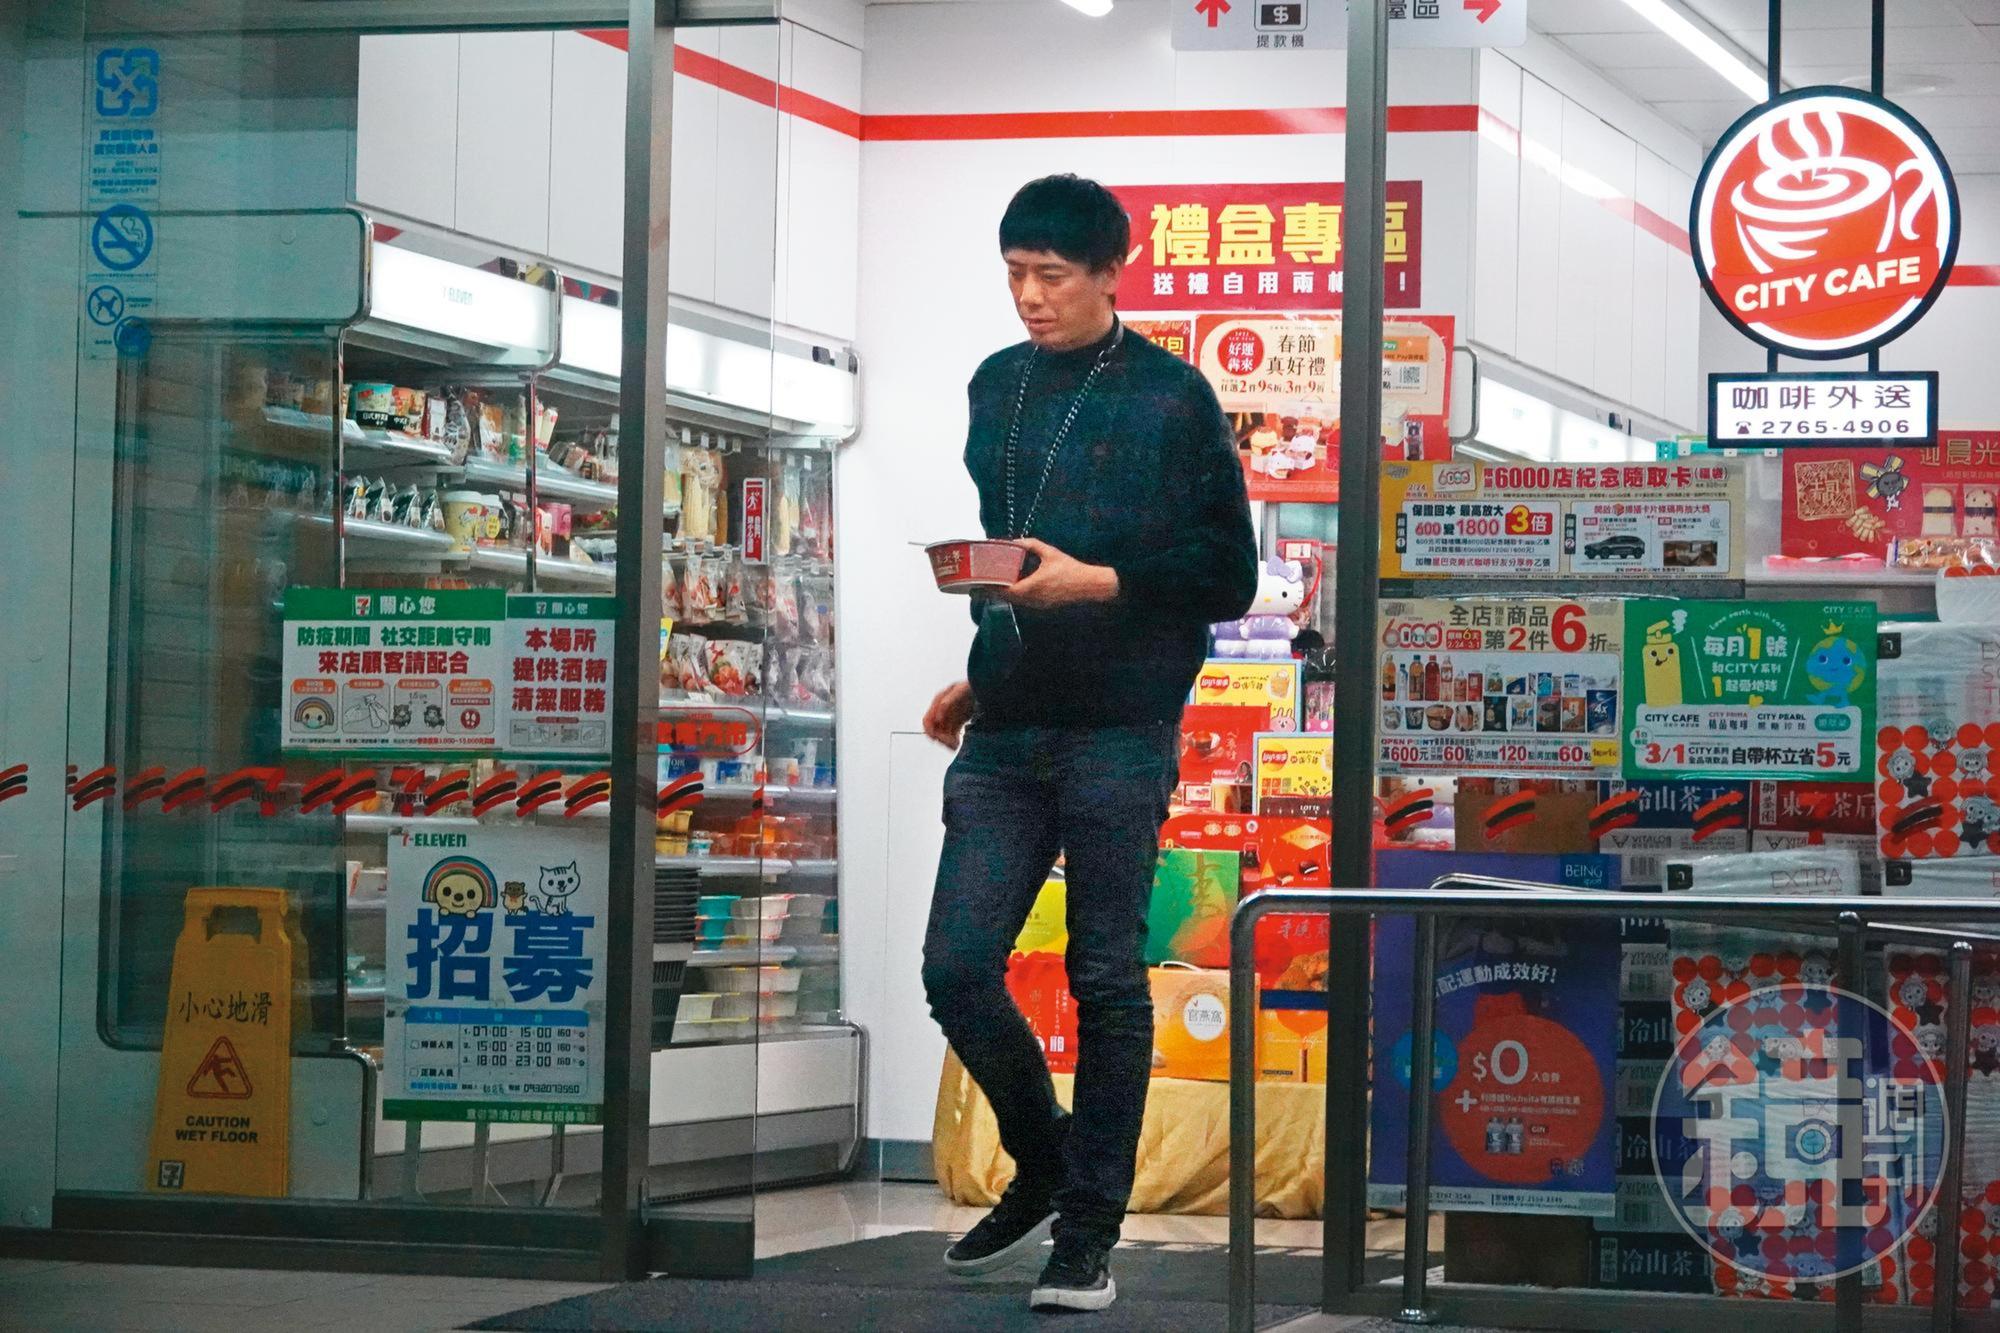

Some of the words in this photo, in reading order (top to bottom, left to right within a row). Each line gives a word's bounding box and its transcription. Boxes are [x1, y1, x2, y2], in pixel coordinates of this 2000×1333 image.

[1256, 34, 1305, 49] 提款機
[1735, 273, 1817, 312] CITY
[1824, 256, 1921, 297] CAFE
[1228, 341, 1255, 356] 好運
[1279, 334, 1316, 354] 春節
[1266, 356, 1326, 376] 真好禮
[1732, 384, 1912, 410] 咖啡外送
[1761, 420, 1910, 434] 2765-4906
[1412, 504, 1456, 517] 保證回本
[1460, 504, 1504, 517] 最高放大
[1511, 504, 1548, 534] 3倍
[379, 595, 436, 615] 關心您
[551, 600, 588, 615] 關心您
[1823, 606, 1845, 614] CITY
[297, 626, 371, 647] 防疫期間
[380, 626, 491, 647] 社交距離守則
[525, 627, 597, 652] 本場所
[1703, 627, 1788, 661] 每月1號
[318, 650, 470, 675] 來店顧客請配合
[512, 657, 607, 683] 提供酒精
[511, 687, 606, 713] 清潔服務
[1645, 714, 1670, 723] CITY
[1673, 714, 1700, 723] CAFE
[1757, 713, 1777, 721] CITY
[1779, 713, 1807, 721] PEARL
[1645, 743, 1685, 765] 3/1
[1731, 742, 1852, 768] 自帶杯立省5元
[405, 907, 595, 1003] 招募
[178, 990, 273, 1027] 小心地滑
[185, 1114, 251, 1129] CAUTION
[175, 1128, 207, 1141] WET
[210, 1129, 259, 1144] FLOOR
